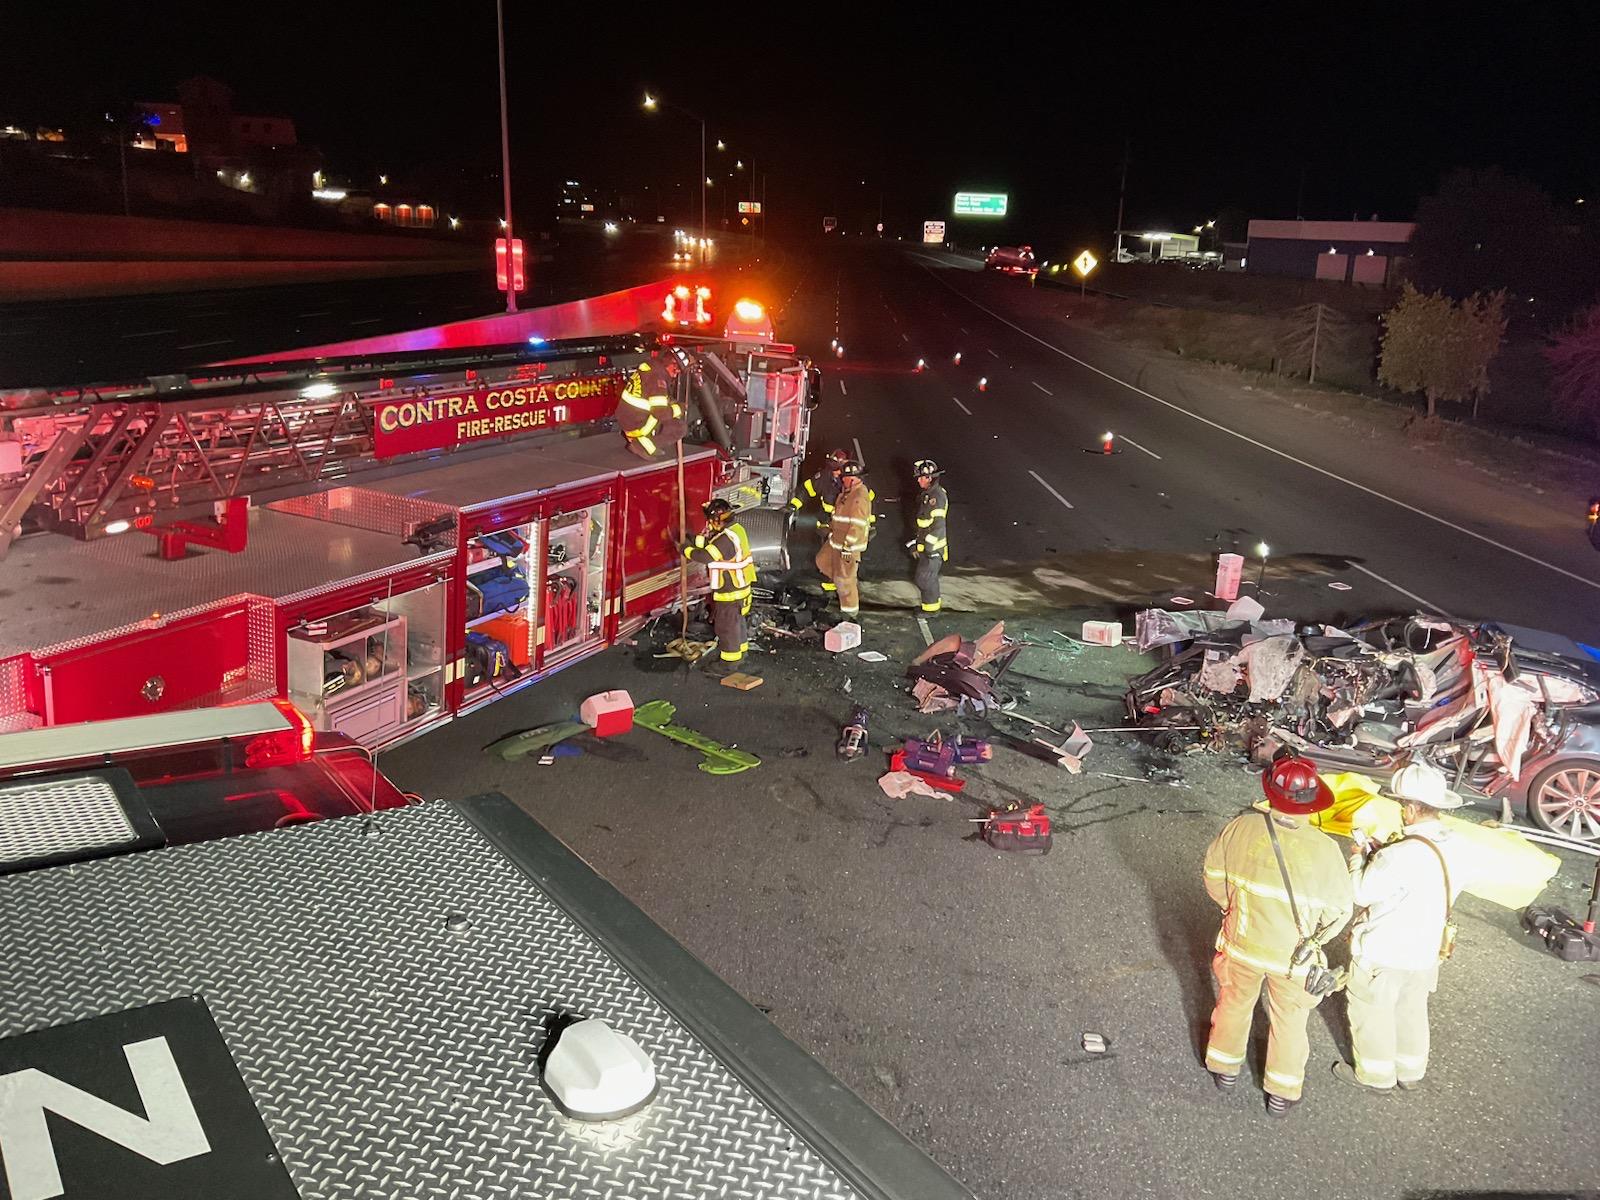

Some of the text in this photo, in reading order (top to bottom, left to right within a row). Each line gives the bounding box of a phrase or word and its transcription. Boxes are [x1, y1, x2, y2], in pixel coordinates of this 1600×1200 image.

[380, 395, 479, 432] CONTRA
[486, 385, 549, 410] COSTA
[457, 409, 546, 439] FIRE-RESCUE
[0, 1035, 212, 1200] N
